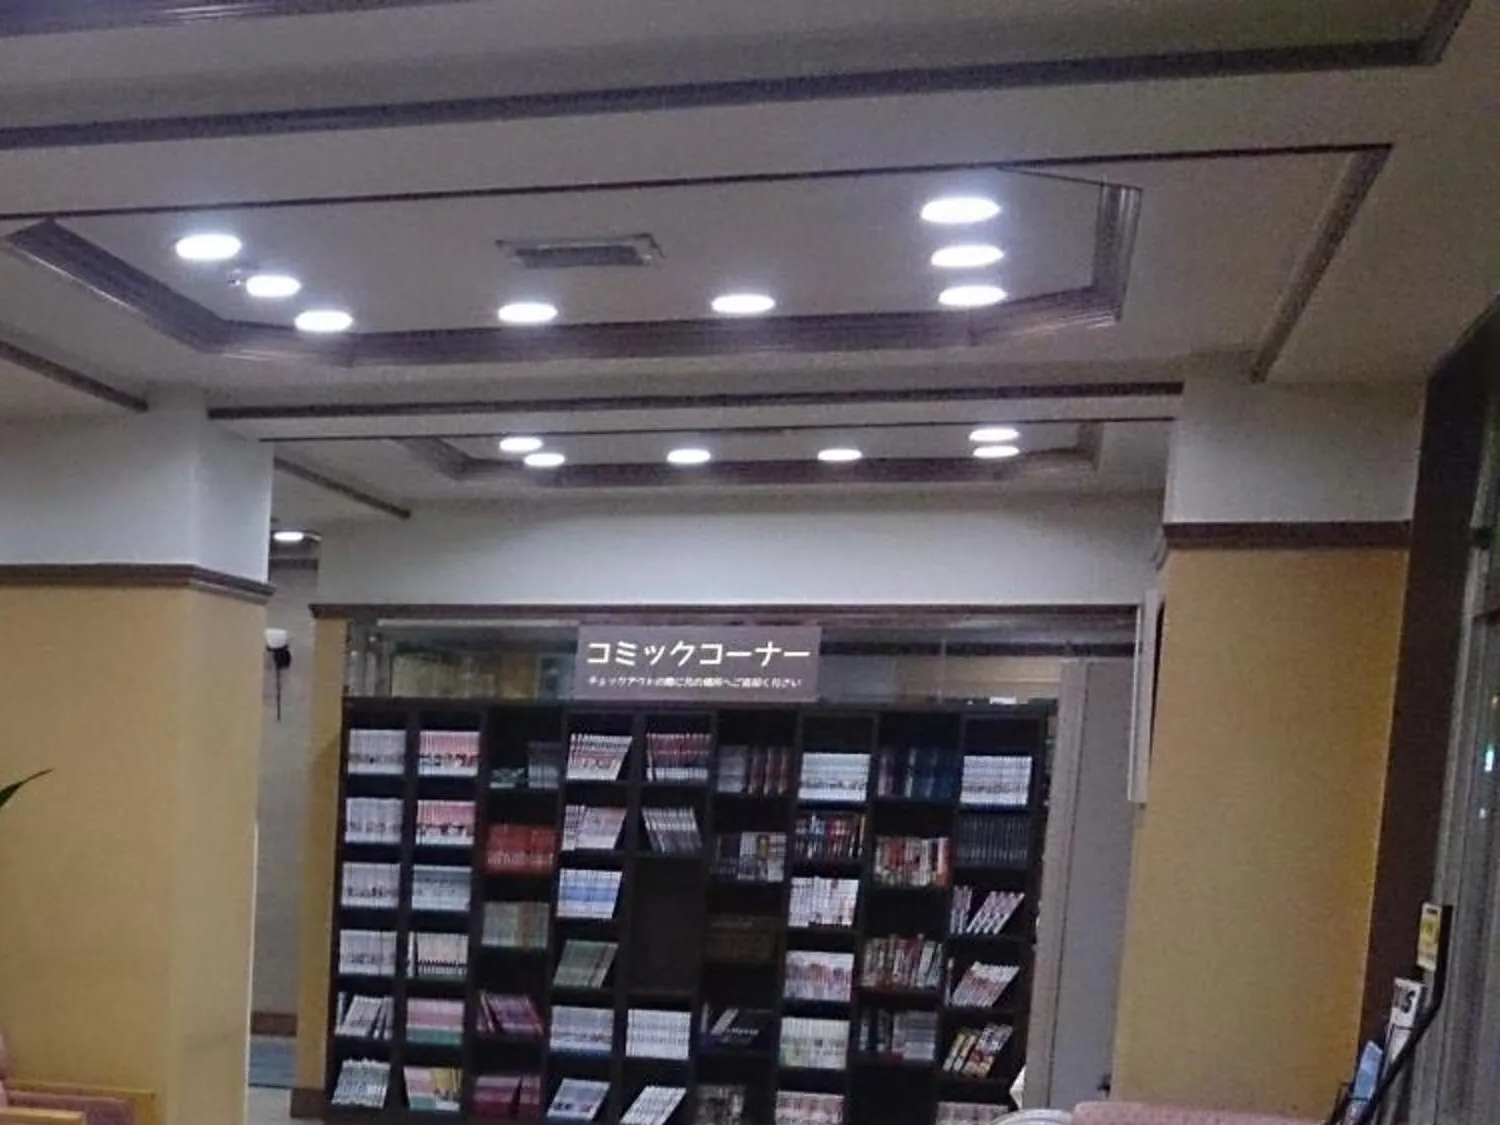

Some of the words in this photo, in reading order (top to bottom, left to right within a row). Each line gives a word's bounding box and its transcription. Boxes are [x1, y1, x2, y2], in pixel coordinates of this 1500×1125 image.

[586, 640, 811, 667] コミックコーナー
